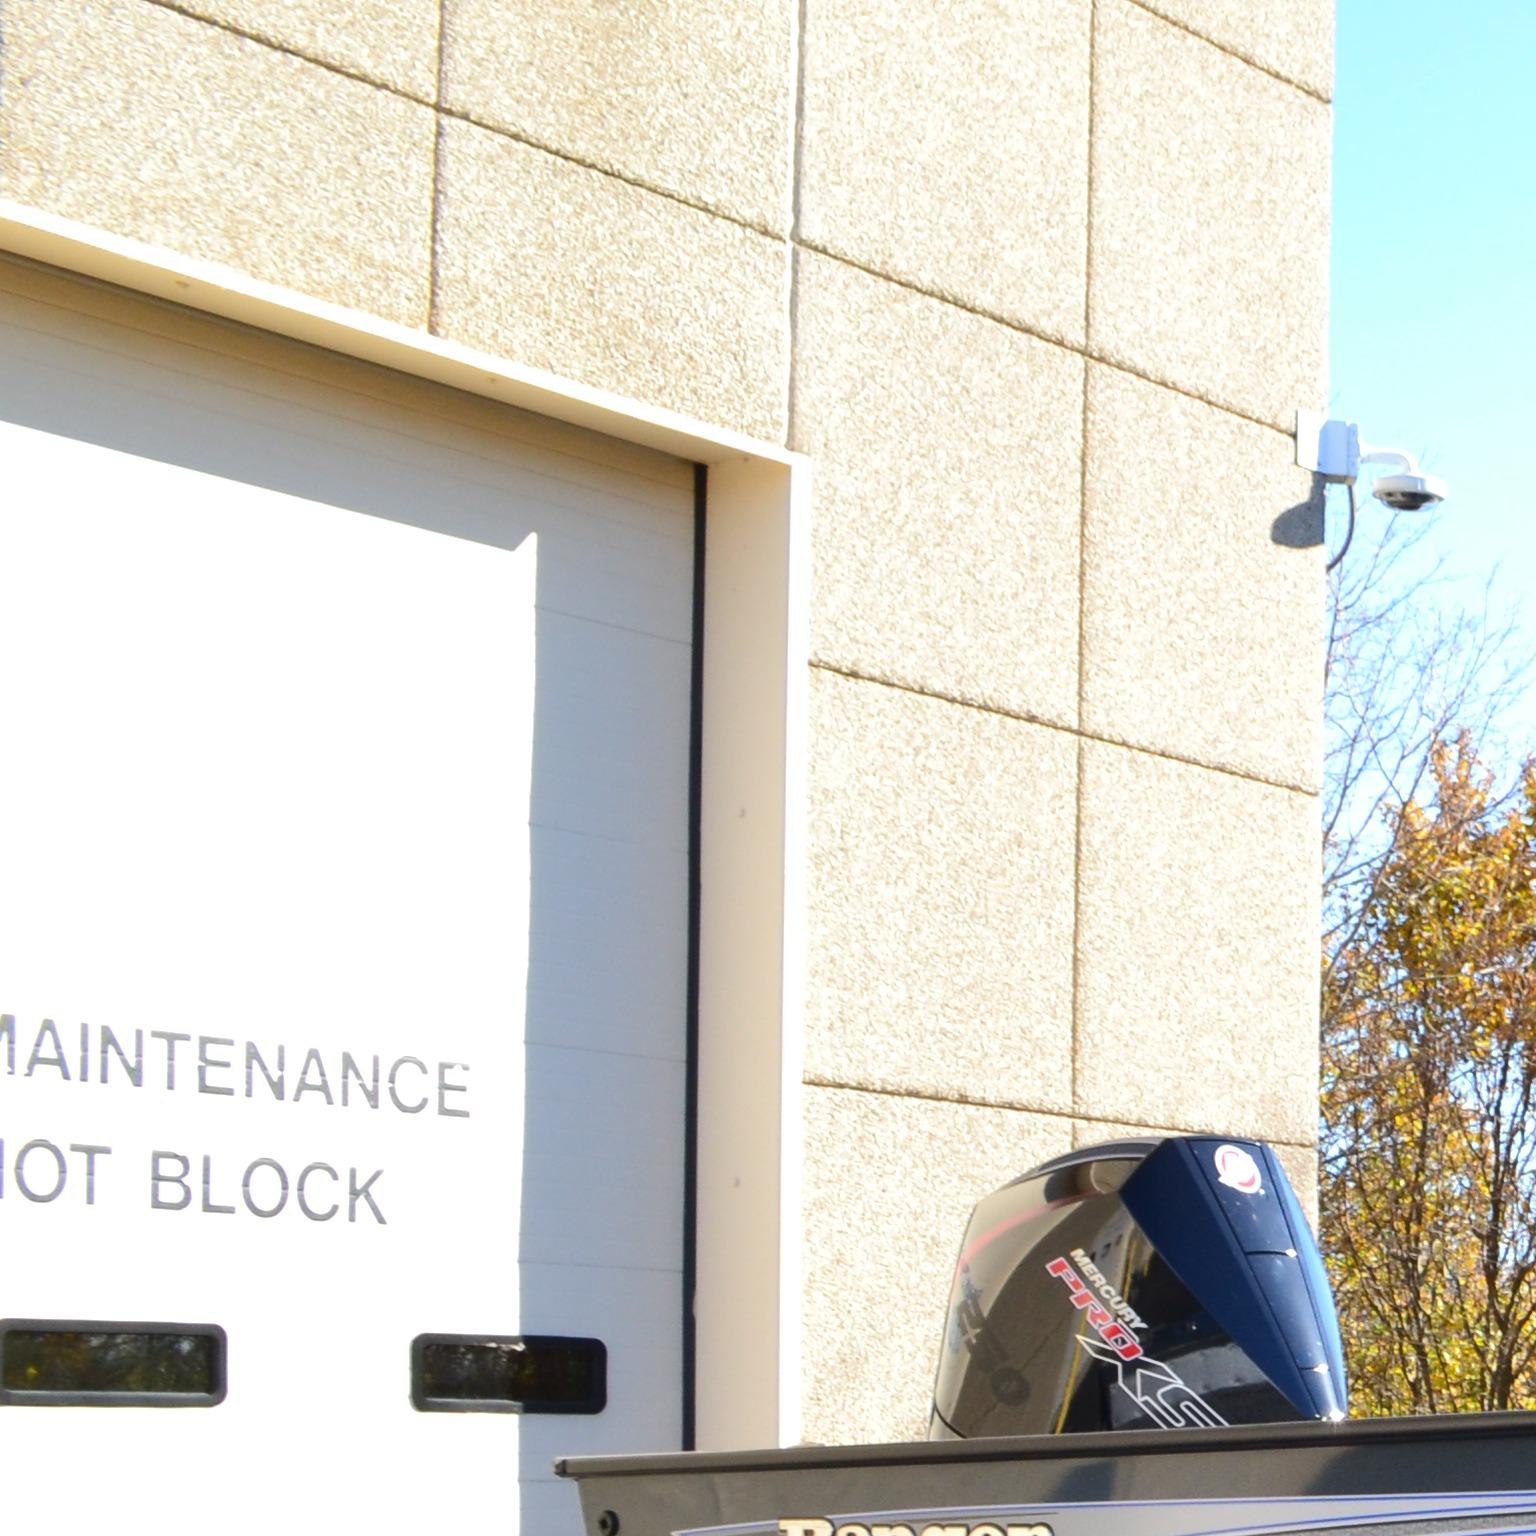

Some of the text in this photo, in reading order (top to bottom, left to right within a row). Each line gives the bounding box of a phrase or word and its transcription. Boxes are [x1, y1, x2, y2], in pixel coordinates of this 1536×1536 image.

[0, 1138, 388, 1225] OT BLOCK
[1045, 1257, 1144, 1361] PRO
[1070, 1248, 1149, 1329] MERCURY
